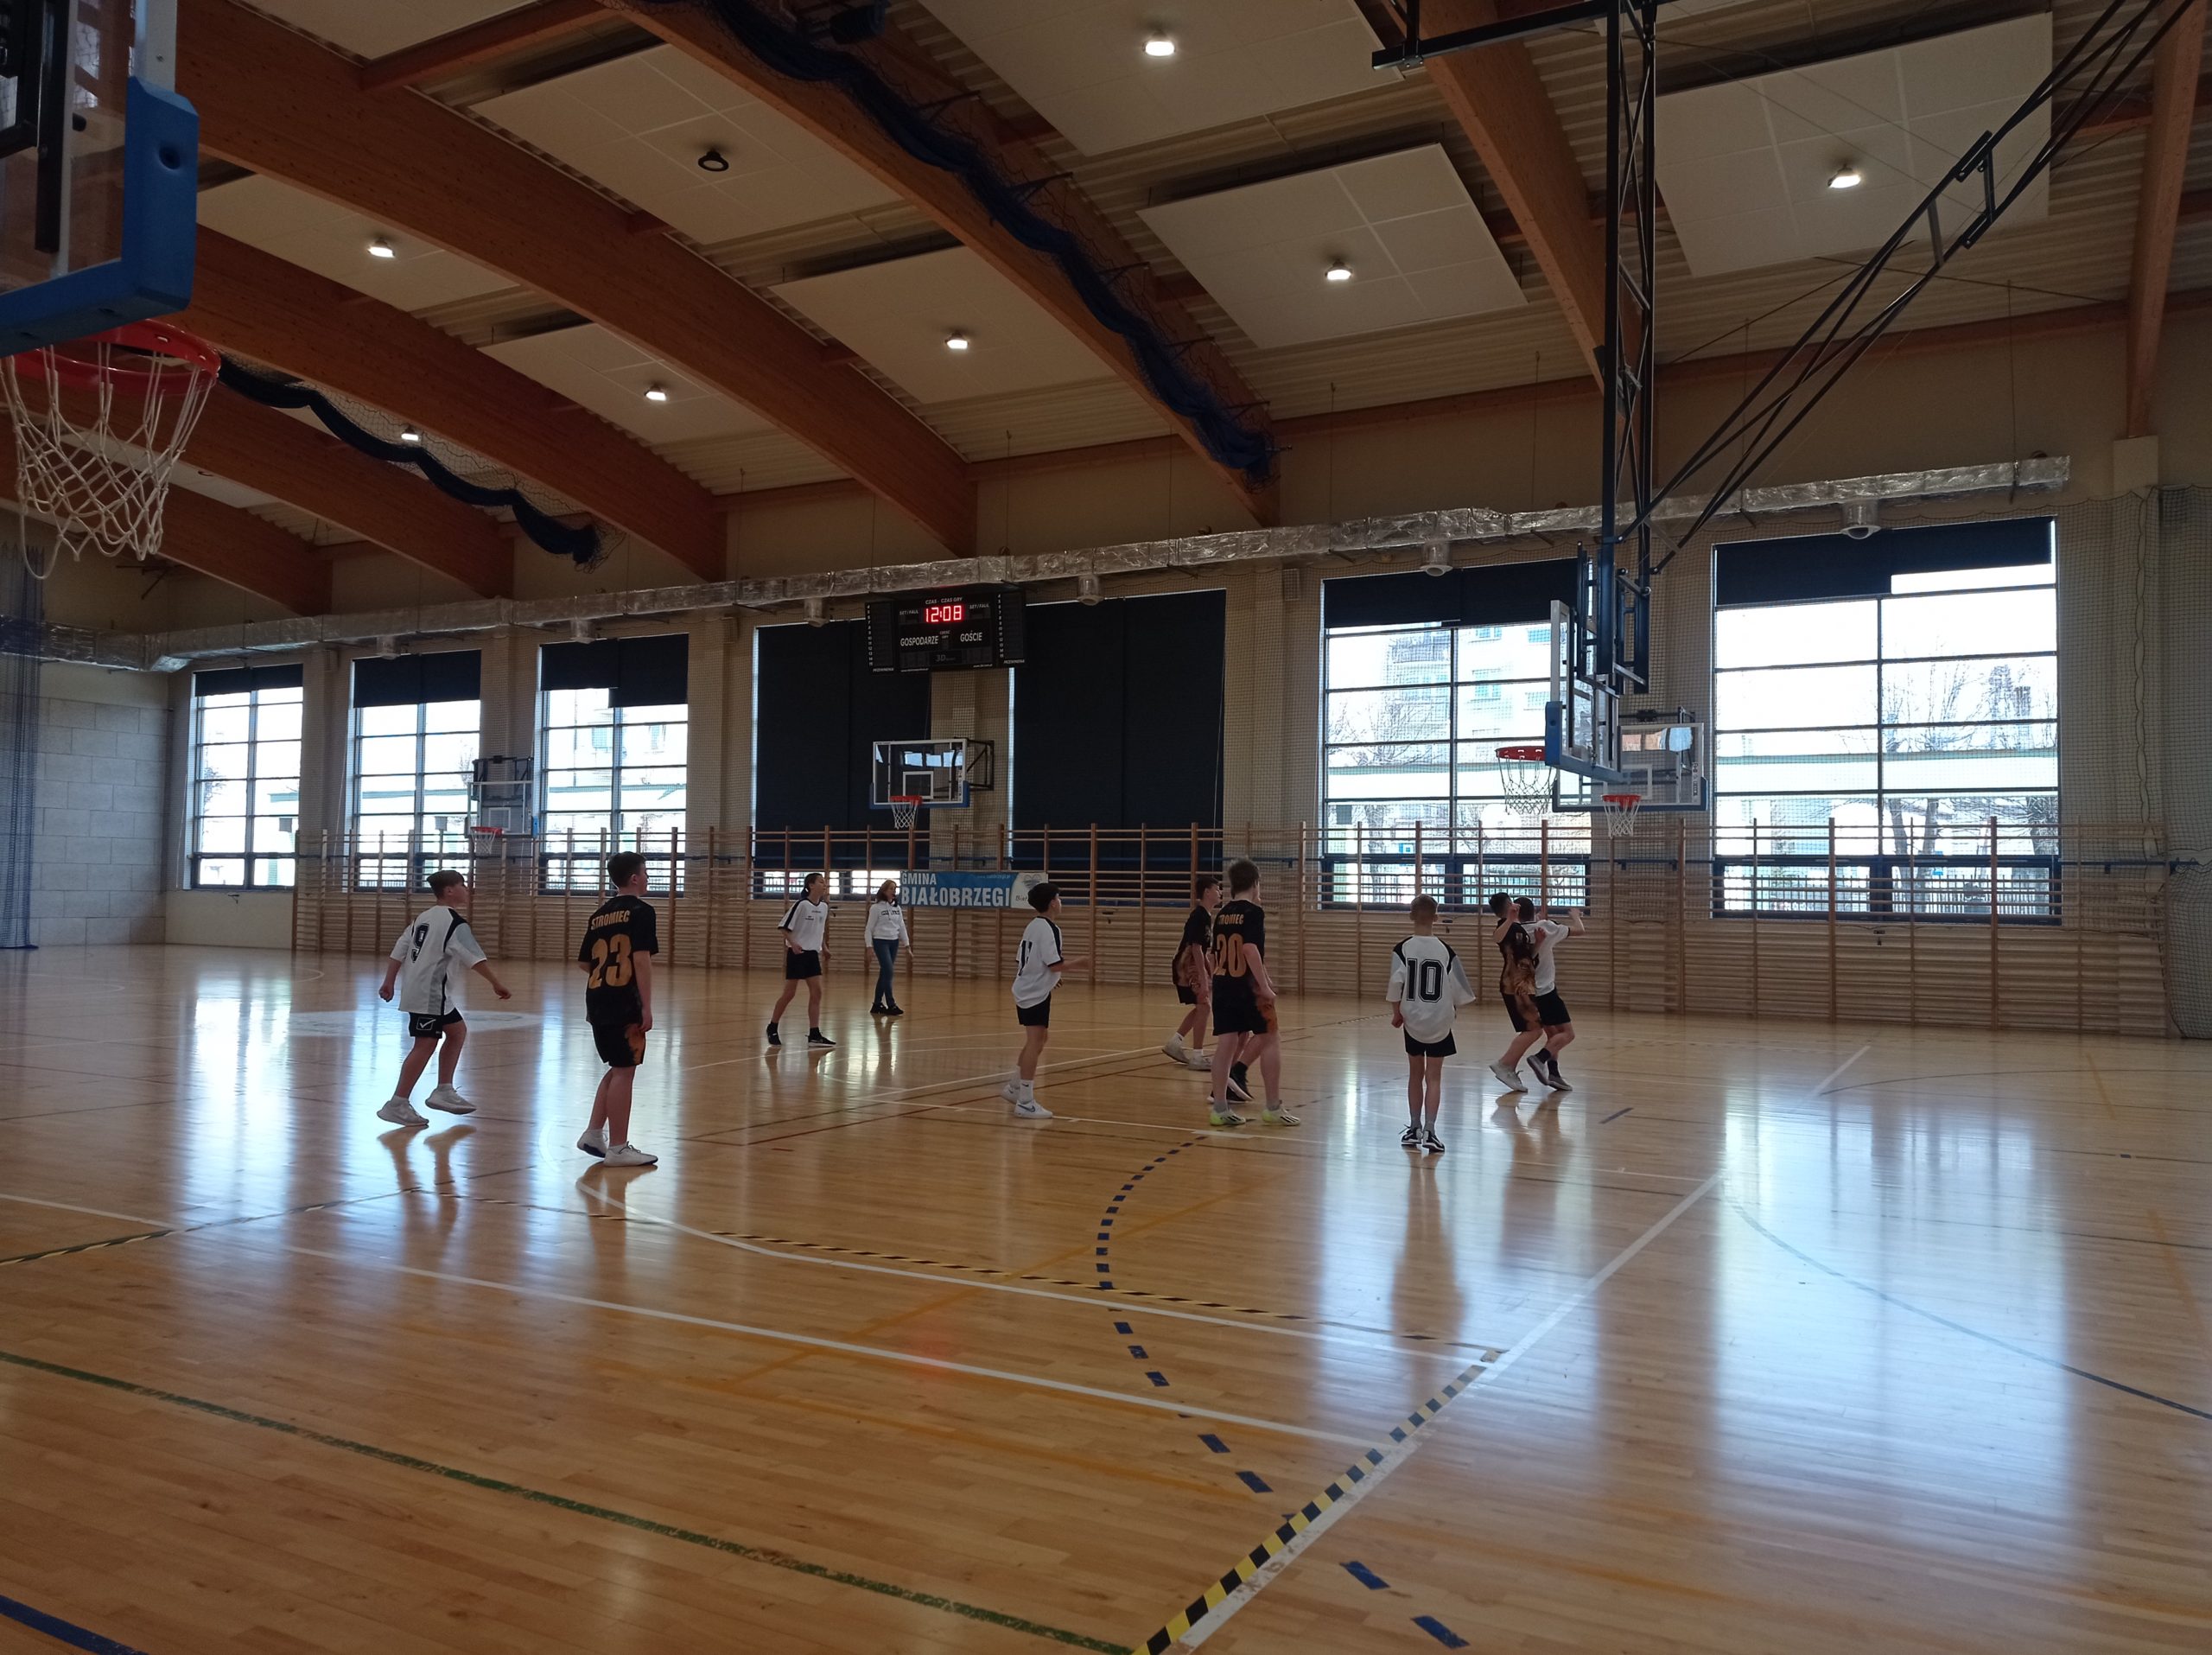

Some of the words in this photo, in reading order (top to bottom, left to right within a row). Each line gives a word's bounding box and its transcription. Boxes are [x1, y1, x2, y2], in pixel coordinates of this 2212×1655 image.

[925, 605, 963, 623] 12:08
[900, 635, 939, 646] GOSPODARZE
[960, 630, 982, 642] GOŚCIE
[901, 872, 937, 885] GMINA
[901, 887, 1010, 907] BIAŁOBRZEGI
[591, 909, 632, 930] STROMIEC
[411, 922, 430, 964] 9
[588, 933, 633, 989] 23
[1213, 933, 1247, 977] 20
[1406, 958, 1444, 1003] 10
